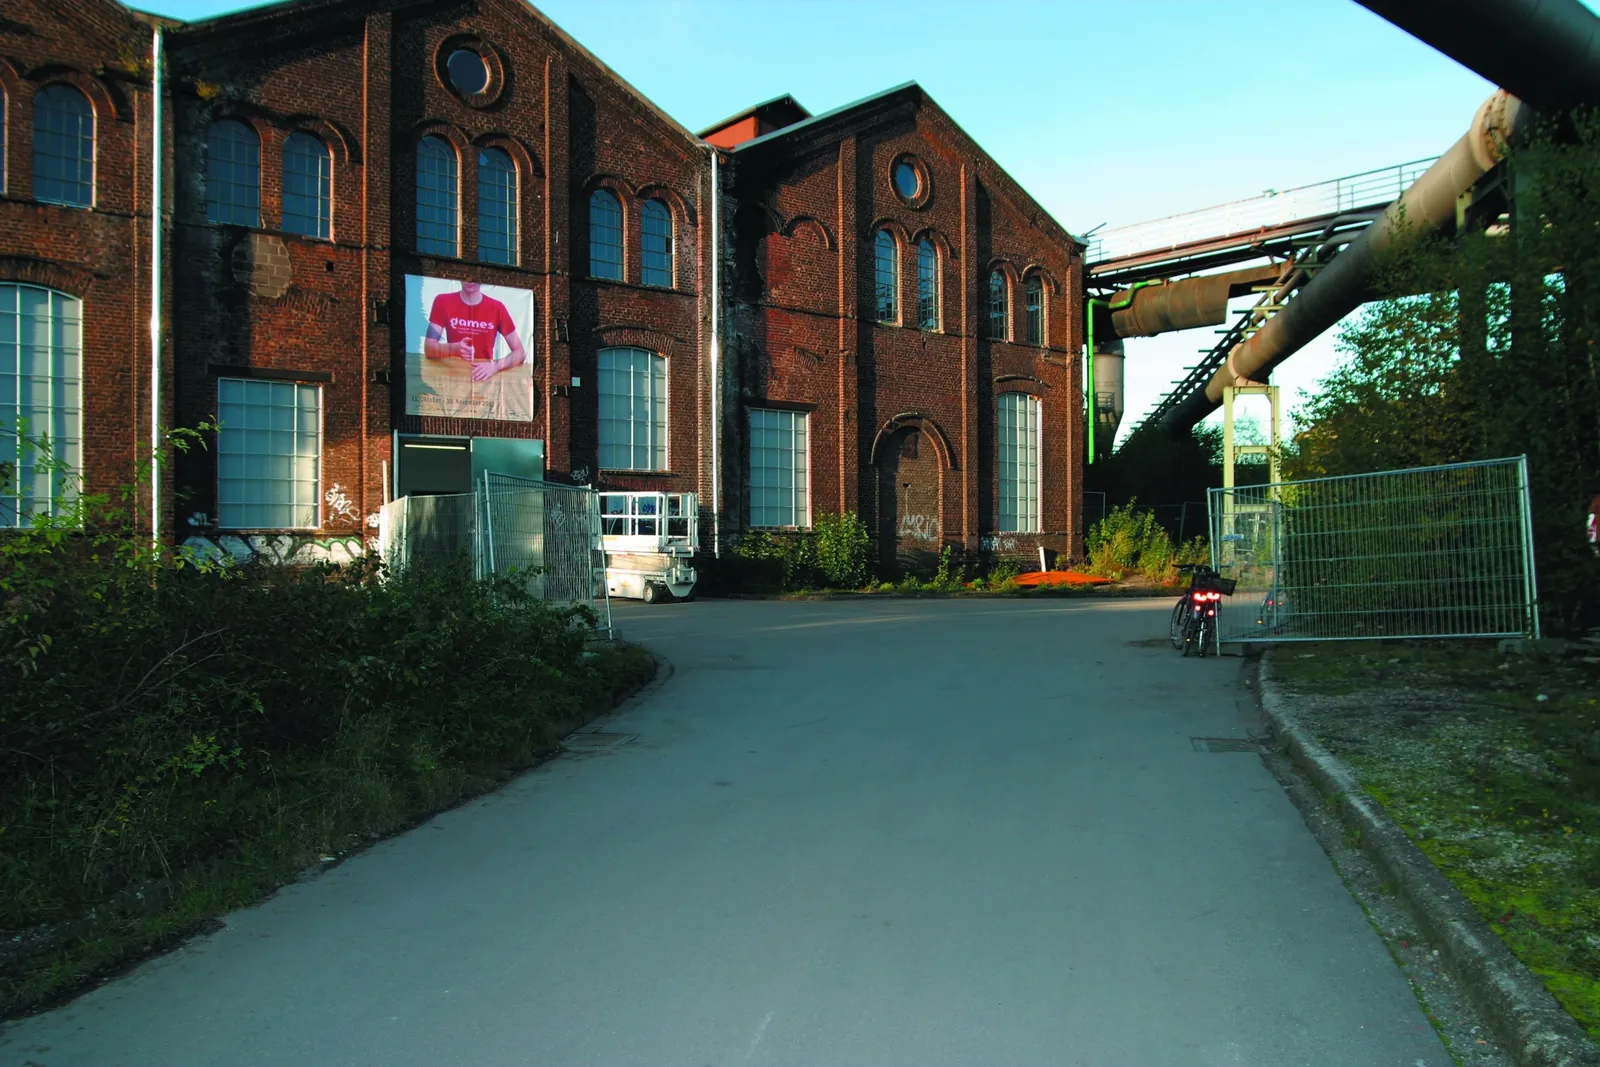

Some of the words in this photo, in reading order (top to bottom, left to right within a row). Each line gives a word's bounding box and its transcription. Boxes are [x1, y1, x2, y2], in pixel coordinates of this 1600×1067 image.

[450, 317, 494, 329] games
[419, 396, 441, 404] Oktober
[455, 398, 481, 406] November
